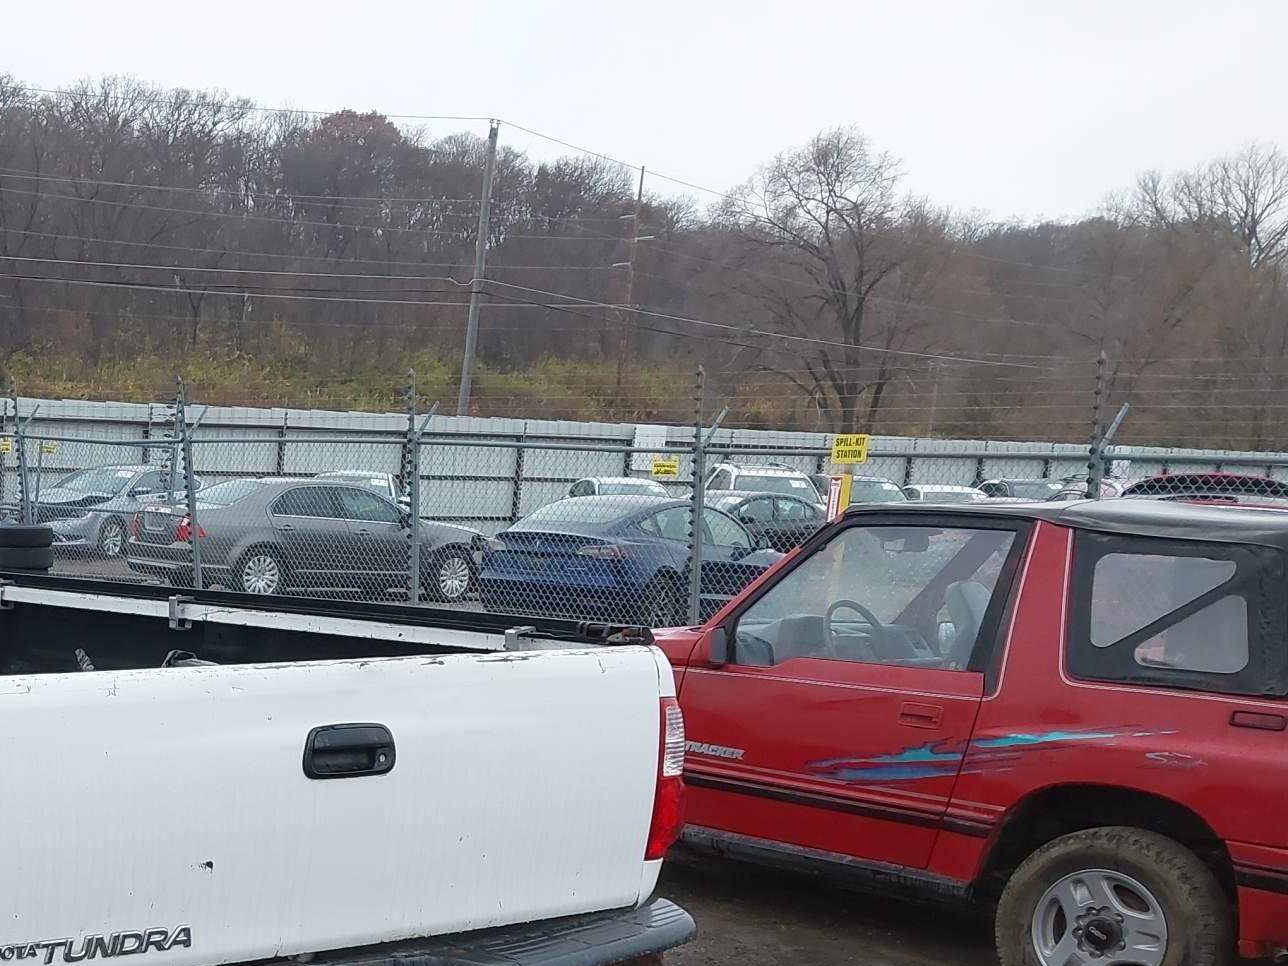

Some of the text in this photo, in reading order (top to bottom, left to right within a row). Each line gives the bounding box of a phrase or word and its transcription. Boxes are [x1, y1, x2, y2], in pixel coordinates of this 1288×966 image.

[835, 437, 866, 447] SPILL-KIT
[836, 449, 862, 459] STATION
[685, 740, 745, 760] TRACKER
[38, 923, 192, 965] TUNDRA
